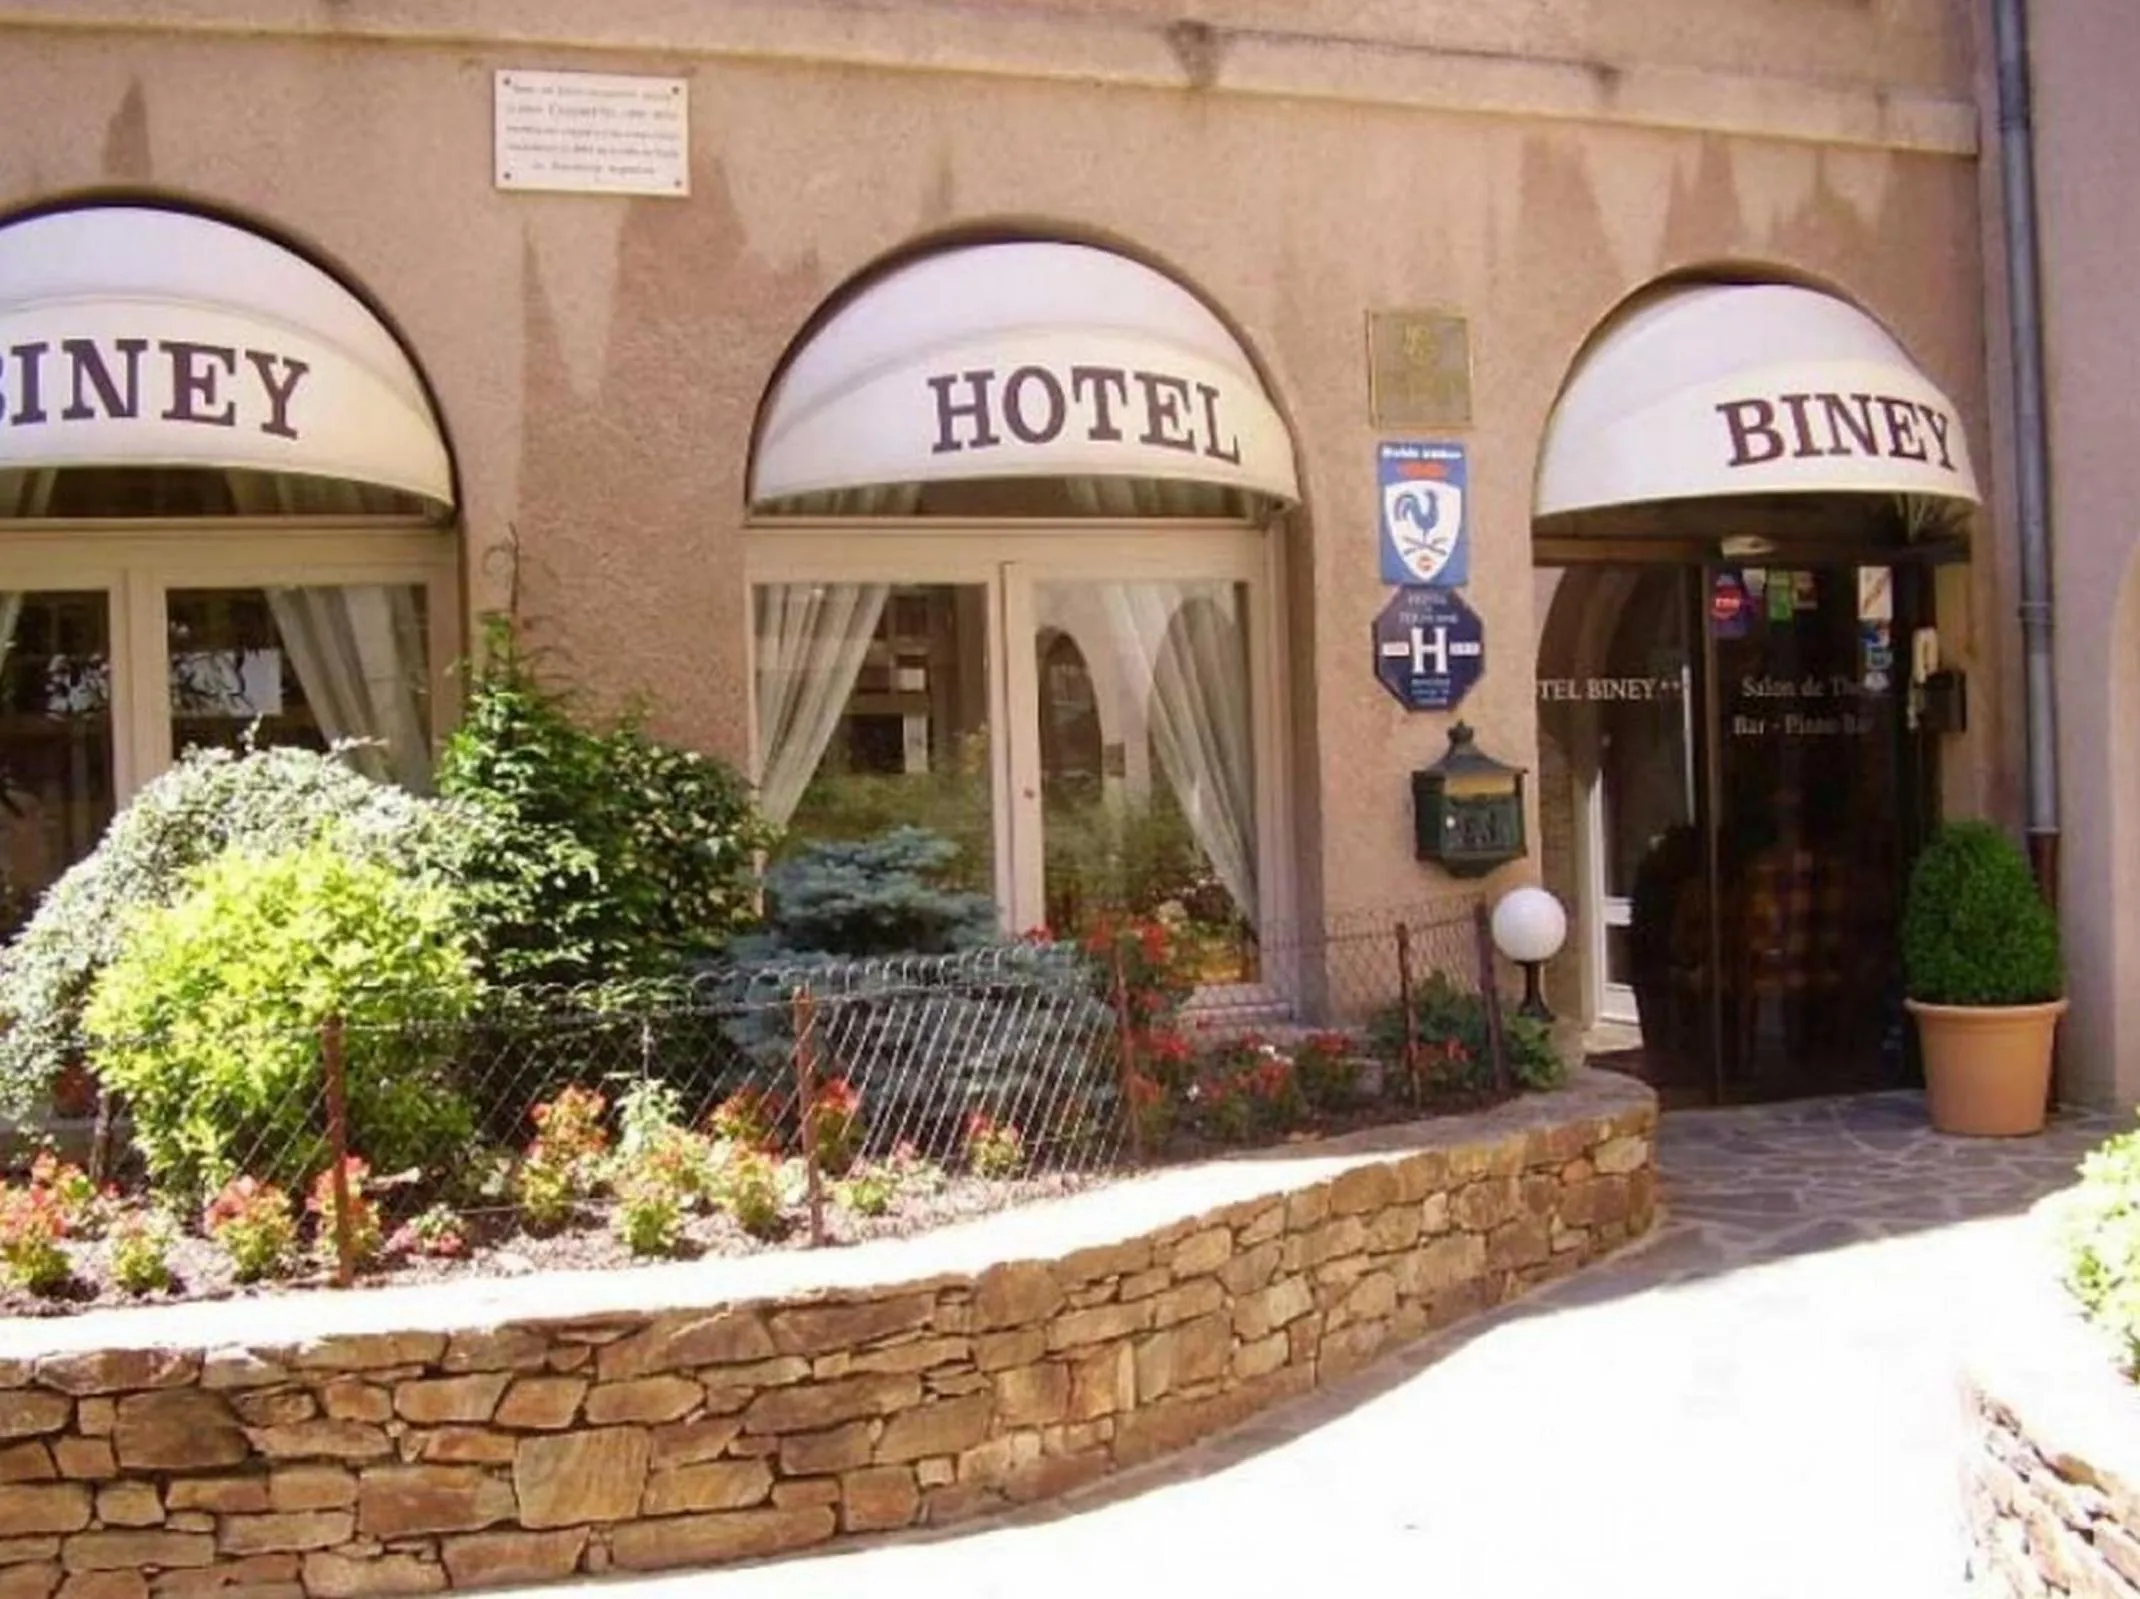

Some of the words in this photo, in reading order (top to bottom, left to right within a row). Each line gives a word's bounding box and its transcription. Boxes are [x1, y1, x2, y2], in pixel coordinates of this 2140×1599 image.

[0, 338, 310, 440] INEY
[927, 365, 1240, 466] HOTEL
[1715, 393, 1957, 472] BINEY
[1411, 626, 1448, 675] H
[1801, 674, 1825, 697] de
[1733, 714, 1765, 735] Bar
